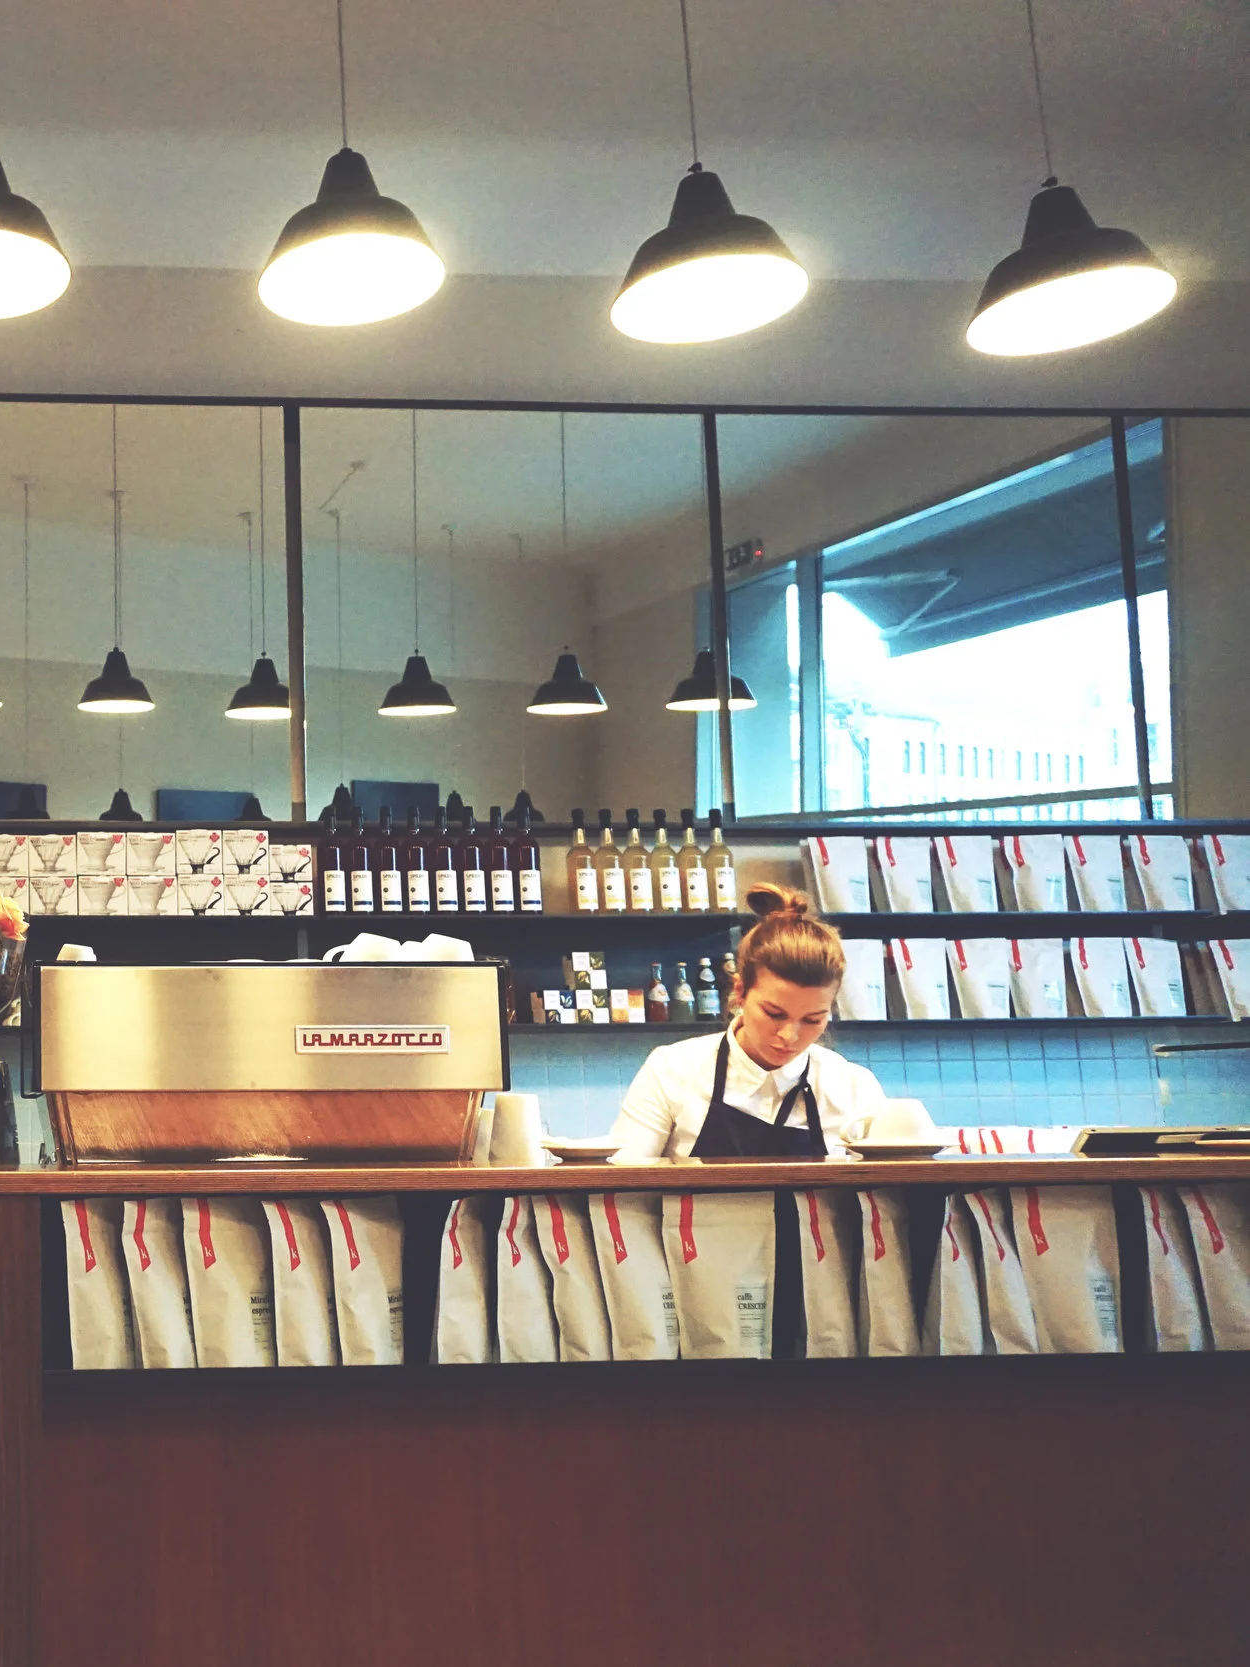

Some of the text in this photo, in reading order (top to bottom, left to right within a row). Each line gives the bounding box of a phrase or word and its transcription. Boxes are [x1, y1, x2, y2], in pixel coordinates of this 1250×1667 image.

[303, 1033, 321, 1047] LA
[1034, 1233, 1044, 1245] k
[204, 1246, 213, 1258] k
[557, 1242, 566, 1253] k
[616, 1241, 624, 1252] k
[685, 1240, 693, 1252] k
[86, 1249, 93, 1261] k
[140, 1248, 148, 1259] k
[291, 1248, 298, 1259] k
[350, 1247, 357, 1259] k
